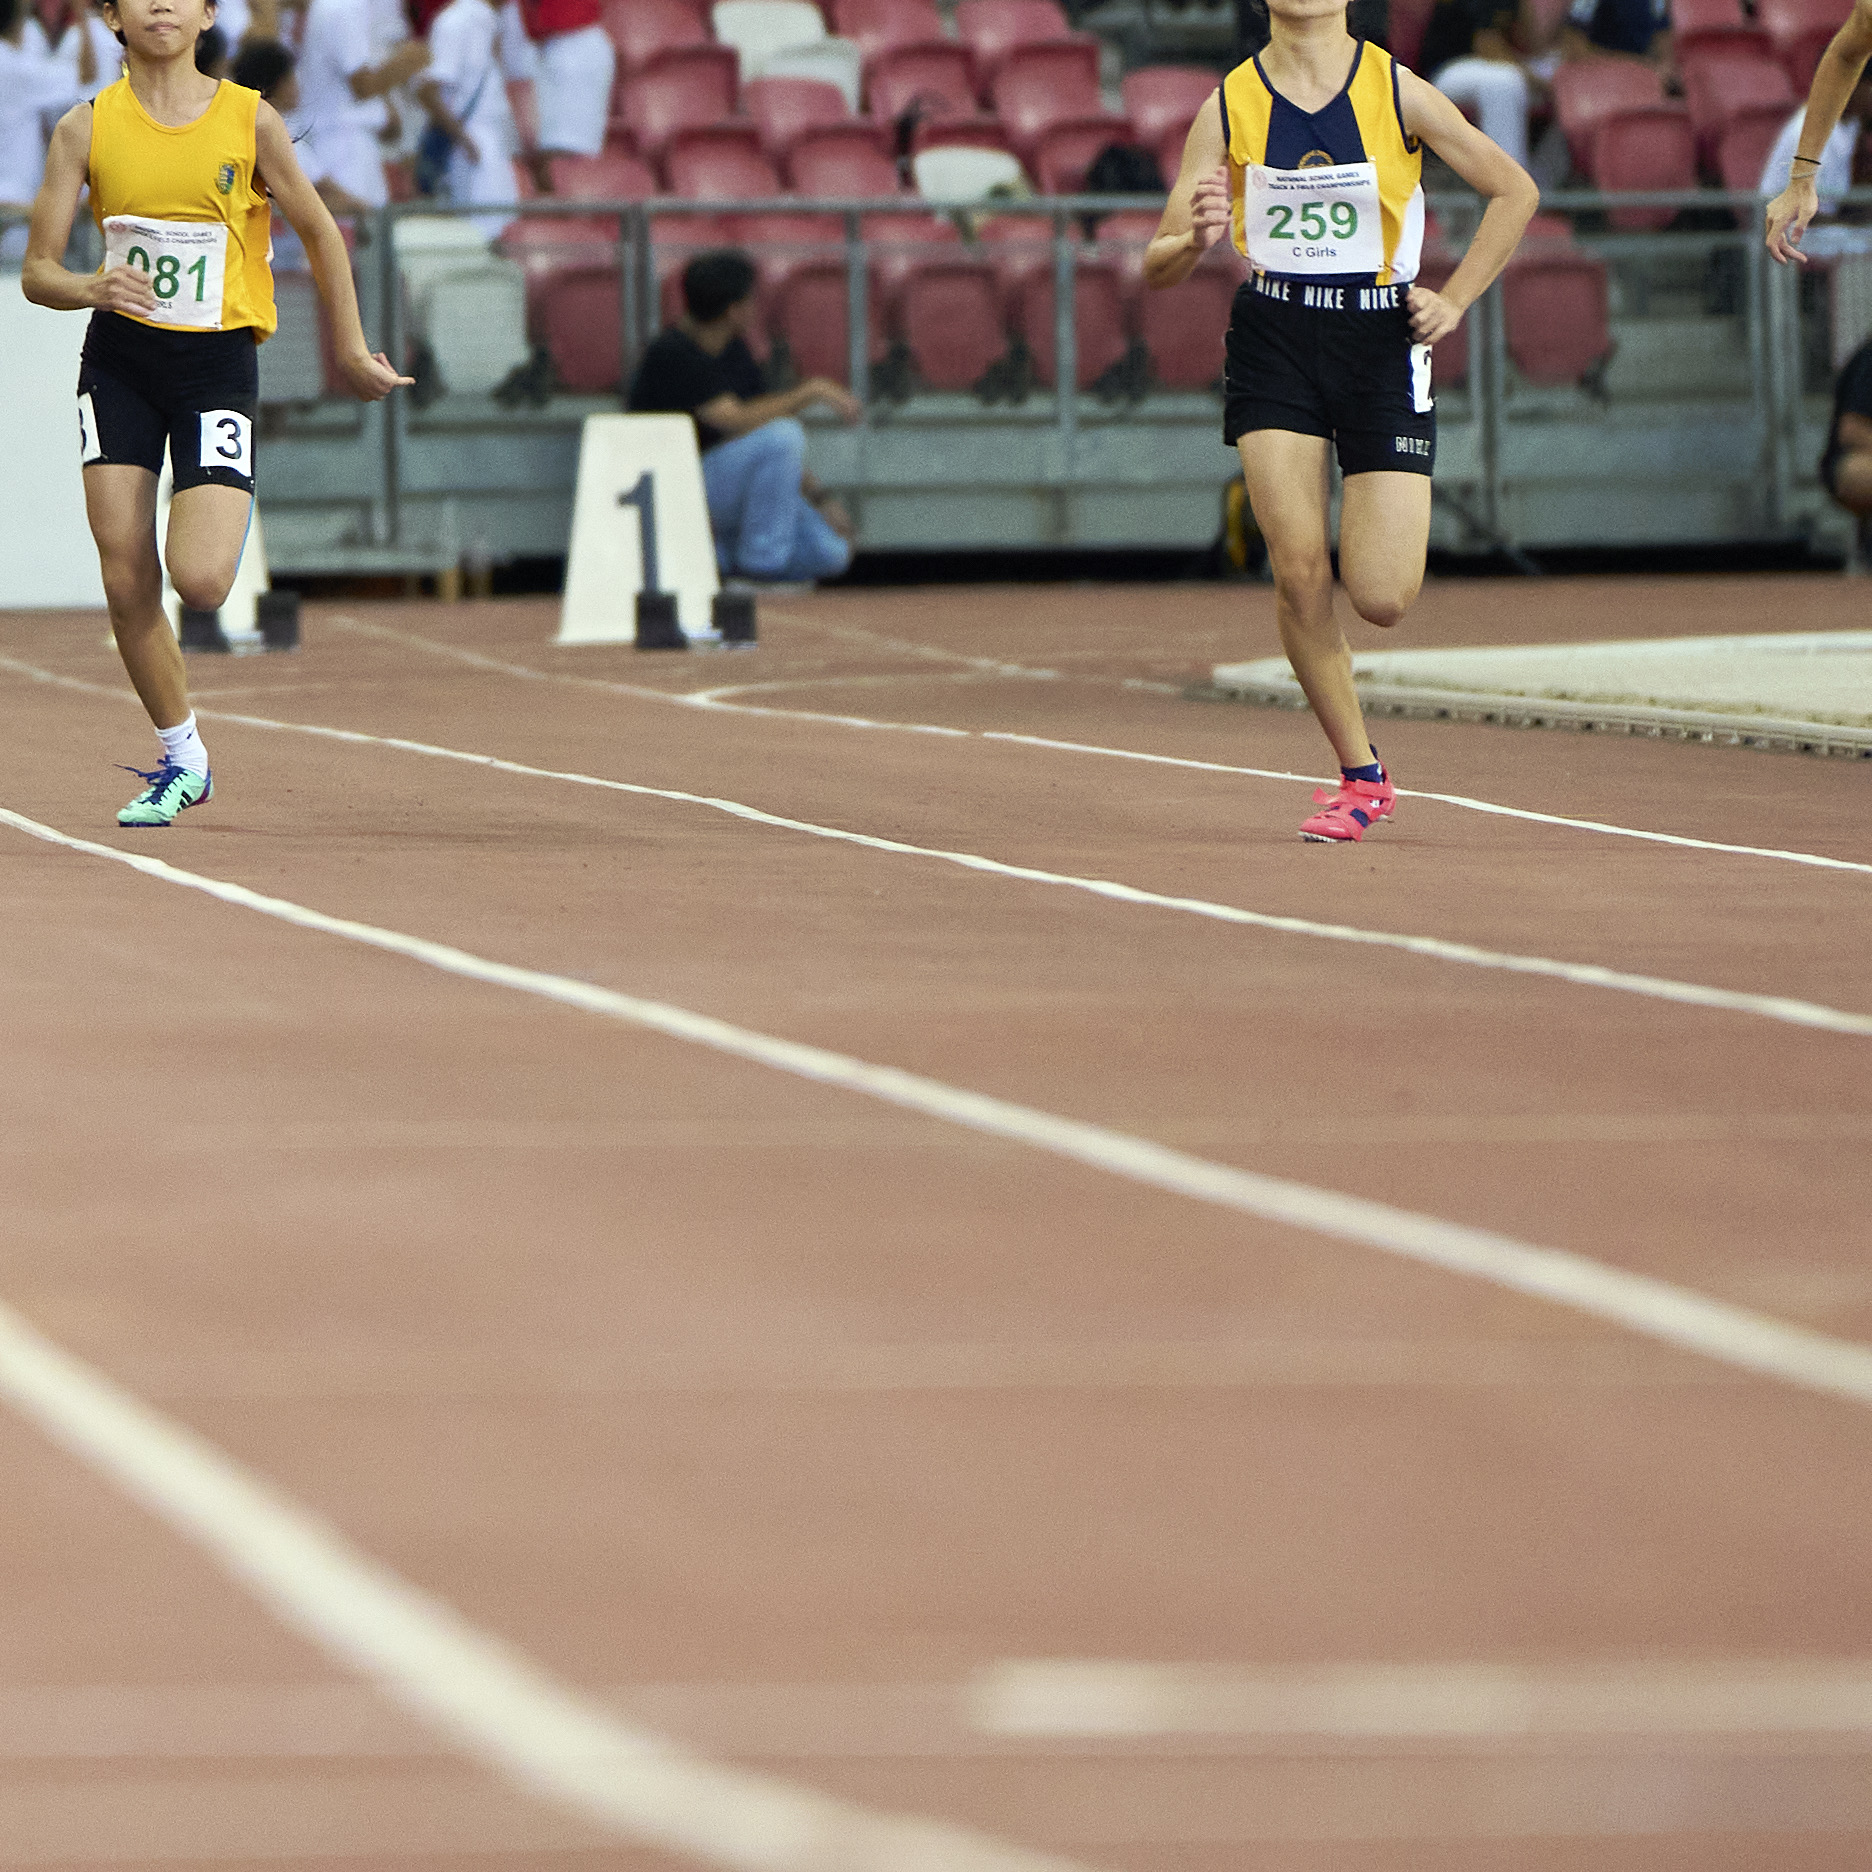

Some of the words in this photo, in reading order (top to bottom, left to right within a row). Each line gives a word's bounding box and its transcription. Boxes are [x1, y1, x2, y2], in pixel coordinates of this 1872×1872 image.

[1266, 201, 1358, 241] 259
[1292, 247, 1301, 257] C
[1306, 246, 1337, 258] Girls
[1257, 276, 1291, 301] NIKE
[1304, 285, 1344, 310] NIKE
[1359, 286, 1400, 310] NIKE
[216, 418, 242, 460] 3
[616, 469, 656, 593] 1
